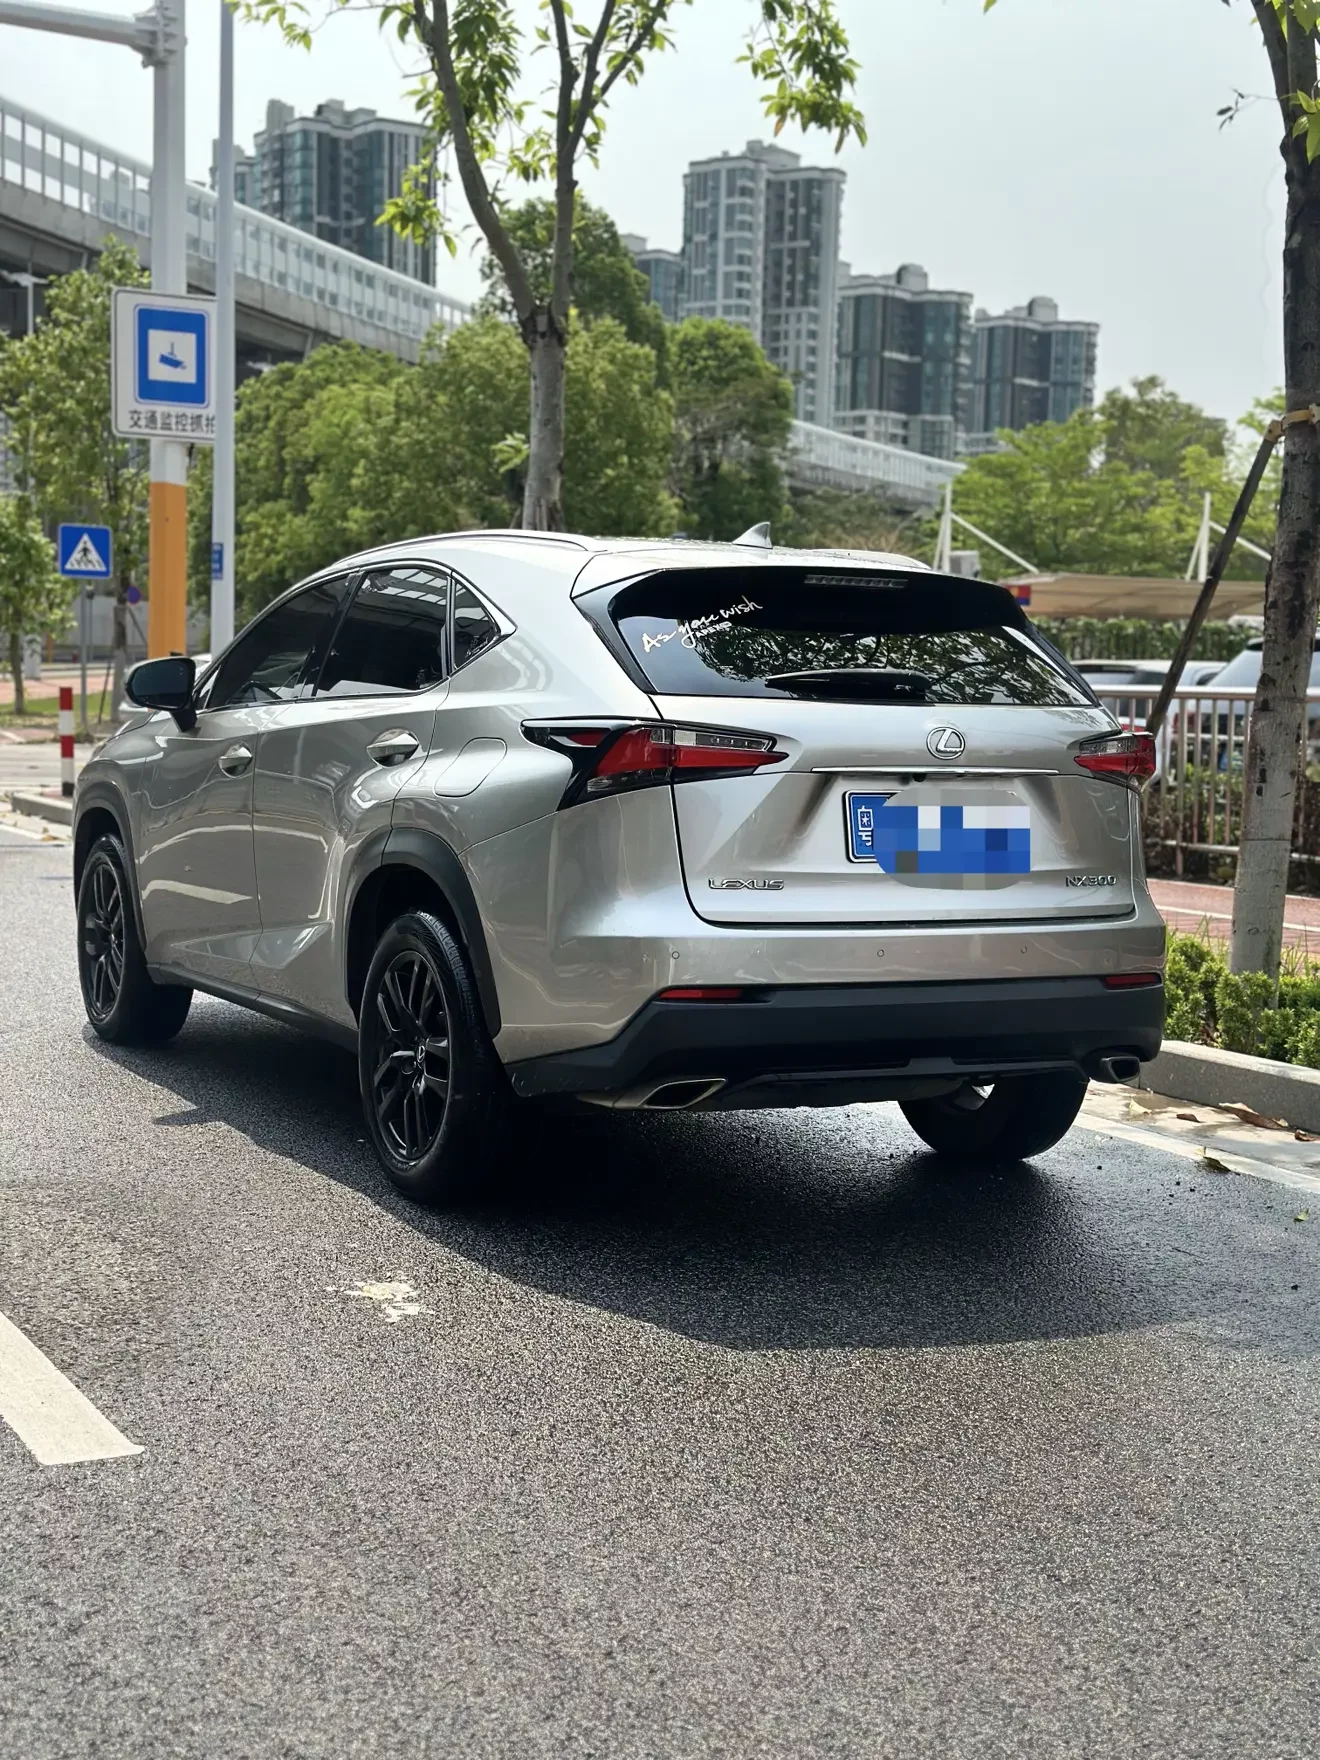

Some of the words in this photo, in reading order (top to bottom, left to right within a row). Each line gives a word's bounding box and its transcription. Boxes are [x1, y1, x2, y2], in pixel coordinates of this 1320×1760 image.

[720, 595, 763, 618] wish
[708, 878, 784, 891] LEXUS
[1065, 875, 1117, 887] NX300
